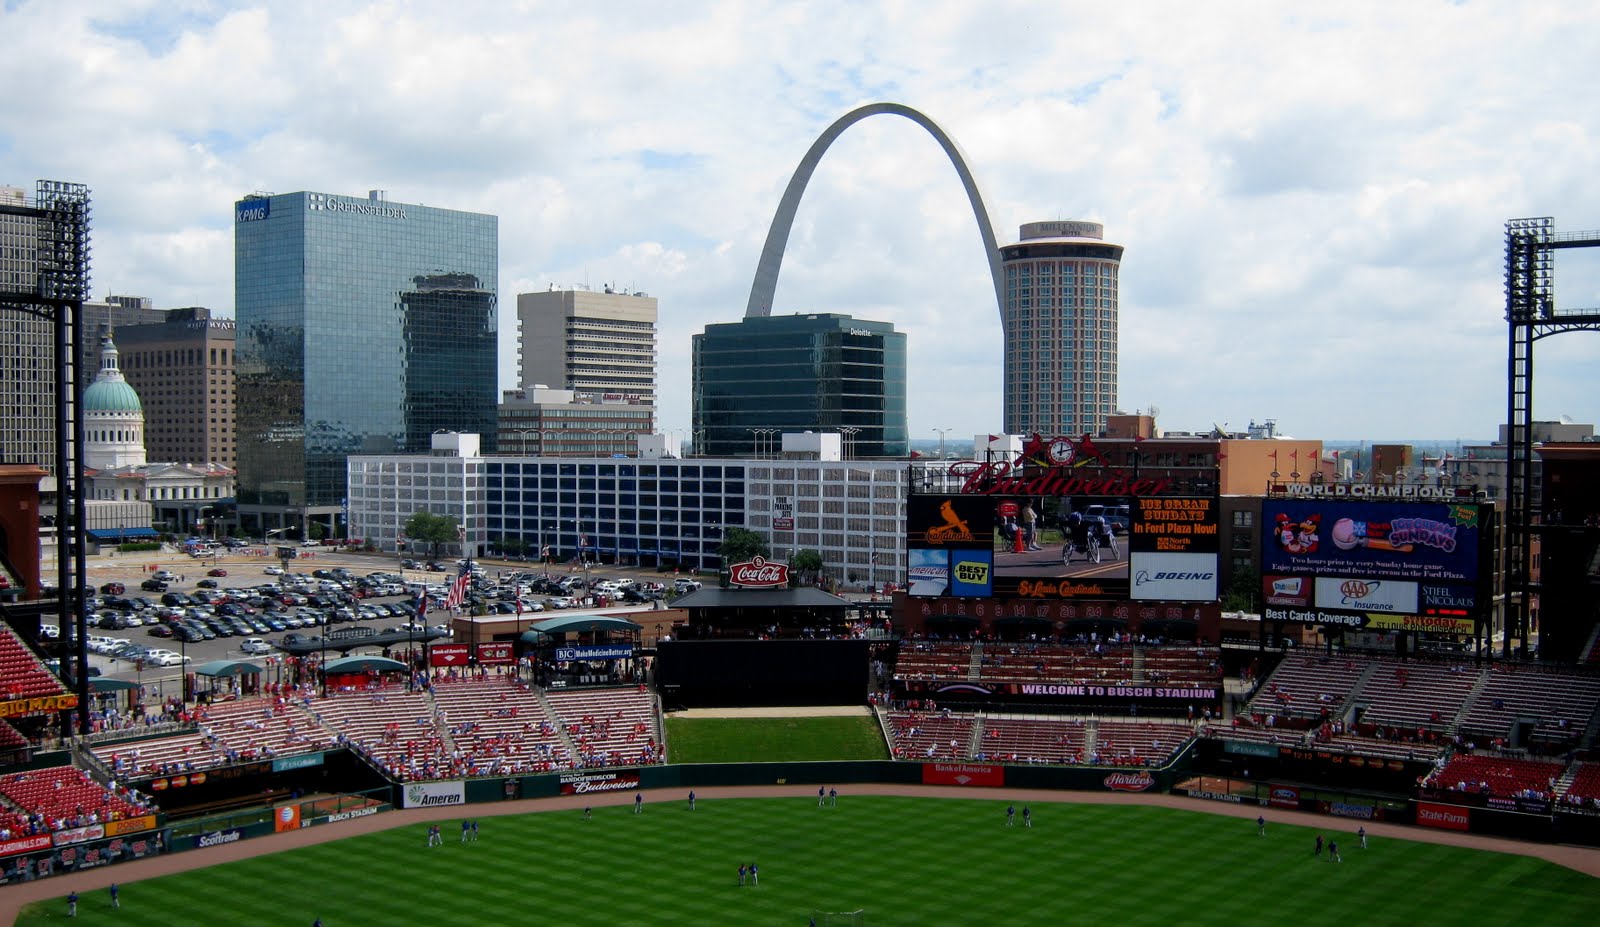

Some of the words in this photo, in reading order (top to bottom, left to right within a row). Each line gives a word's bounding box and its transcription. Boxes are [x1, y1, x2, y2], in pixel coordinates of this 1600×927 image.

[237, 208, 266, 222] KPMG
[326, 198, 408, 219] GREENSFELDER
[949, 461, 1174, 496] Budweiser
[1286, 483, 1345, 496] WORLD
[1350, 483, 1456, 498] CHAMPIONS
[1140, 499, 1162, 510] ICE
[1164, 499, 1210, 510] CREAM
[1143, 510, 1205, 520] SUNDAYS
[926, 526, 976, 544] Cardinals
[1134, 522, 1143, 534] In
[1145, 522, 1165, 534] Ford
[1167, 522, 1192, 534] Plaza
[1194, 523, 1217, 534] Now!
[1389, 530, 1456, 552] SUNDAYS
[958, 564, 987, 574] BEST
[1291, 556, 1306, 565] Two
[1307, 557, 1326, 565] hours
[1327, 557, 1345, 567] prior
[1346, 558, 1354, 566] to
[1356, 560, 1374, 570] every
[1375, 559, 1402, 571] Sunday
[1403, 561, 1422, 570] home
[959, 572, 985, 581] BUY
[1154, 572, 1215, 581] BOEING
[1272, 562, 1291, 572] Enjoy
[1315, 564, 1337, 574] prizes
[1352, 566, 1366, 575] free
[1367, 567, 1377, 575] ice
[1402, 568, 1409, 577] in
[1410, 568, 1422, 577] the
[1423, 569, 1441, 578] Ford
[1443, 570, 1466, 580] Plaza.
[1059, 580, 1105, 597] Cardinals
[1342, 581, 1366, 596] AAA
[1422, 585, 1451, 597] STIFEL
[1354, 601, 1393, 611] Insurance
[1426, 595, 1474, 607] NICOLAUS
[941, 604, 947, 614] 1
[957, 604, 966, 615] 2
[994, 605, 1003, 616] 9
[1013, 605, 1026, 617] 14
[1036, 606, 1049, 618] 17
[1059, 606, 1075, 618] 20
[1086, 606, 1102, 618] 24
[1112, 607, 1129, 619] 42
[1265, 608, 1287, 620] Best
[1289, 610, 1315, 622] Cards
[1318, 611, 1361, 625] Coverage
[558, 649, 574, 660] BJC
[1022, 684, 1085, 696] WELCOME
[1087, 686, 1104, 696] TO
[1107, 686, 1152, 698] BUSCH
[1155, 687, 1215, 699] STADIUM
[0, 701, 27, 717] BIG
[29, 697, 67, 711] MAC
[935, 764, 952, 772] Bank
[961, 765, 992, 774] America
[573, 780, 639, 794] Budweiser
[420, 794, 460, 806] Ameren
[1188, 789, 1211, 799] BUSCH
[1212, 792, 1241, 802] STADIUM
[328, 812, 350, 822] BUSCH
[351, 807, 377, 818] STADIUM
[1419, 809, 1443, 821] State
[1443, 811, 1468, 824] Farm
[116, 818, 147, 830] DOBBS
[199, 830, 241, 848] Scottrade
